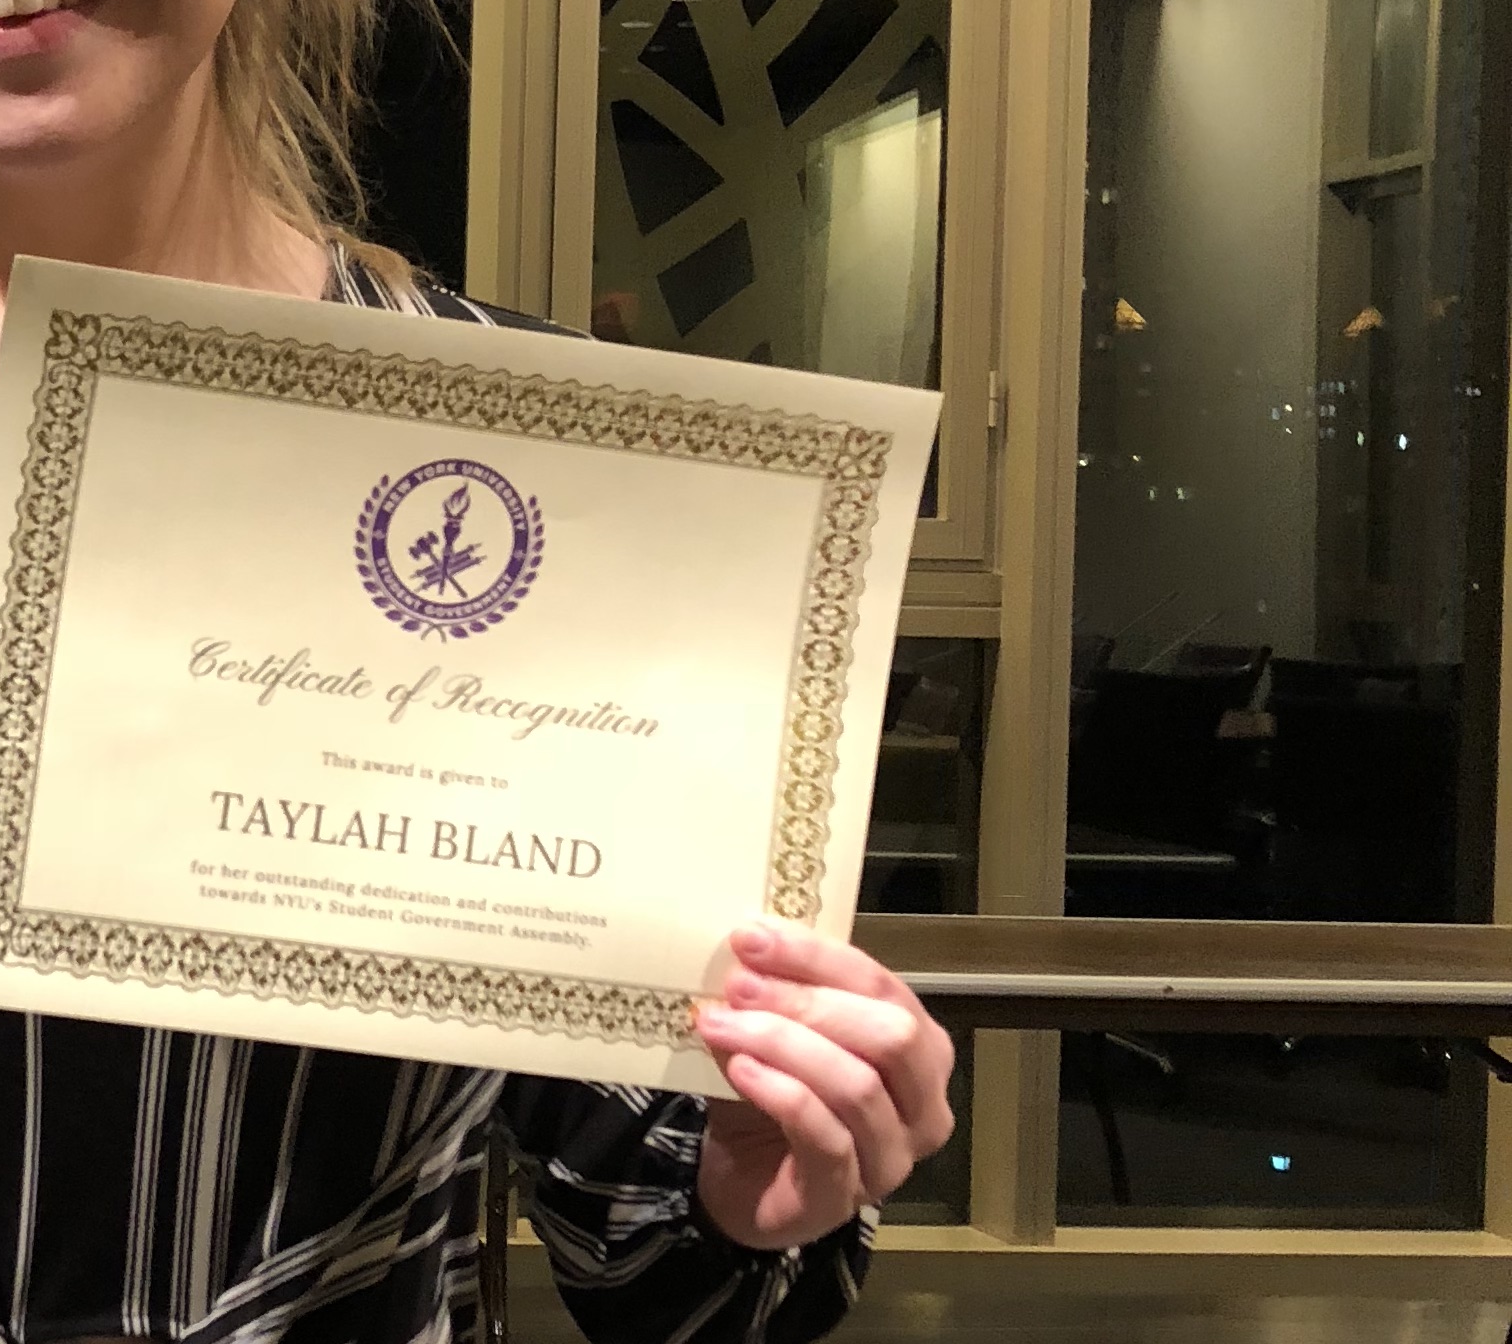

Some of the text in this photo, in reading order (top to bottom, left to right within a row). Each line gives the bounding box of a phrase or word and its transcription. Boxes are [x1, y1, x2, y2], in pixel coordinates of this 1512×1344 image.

[414, 462, 456, 482] YORK
[188, 636, 660, 741] Certificate of Recognition
[322, 750, 509, 789] This award is given to
[210, 790, 603, 879] TAYLAH BLAND
[190, 859, 608, 928] for her outstanding dedication and contributions
[199, 884, 592, 951] towards NYU's Student Government Assembly.
